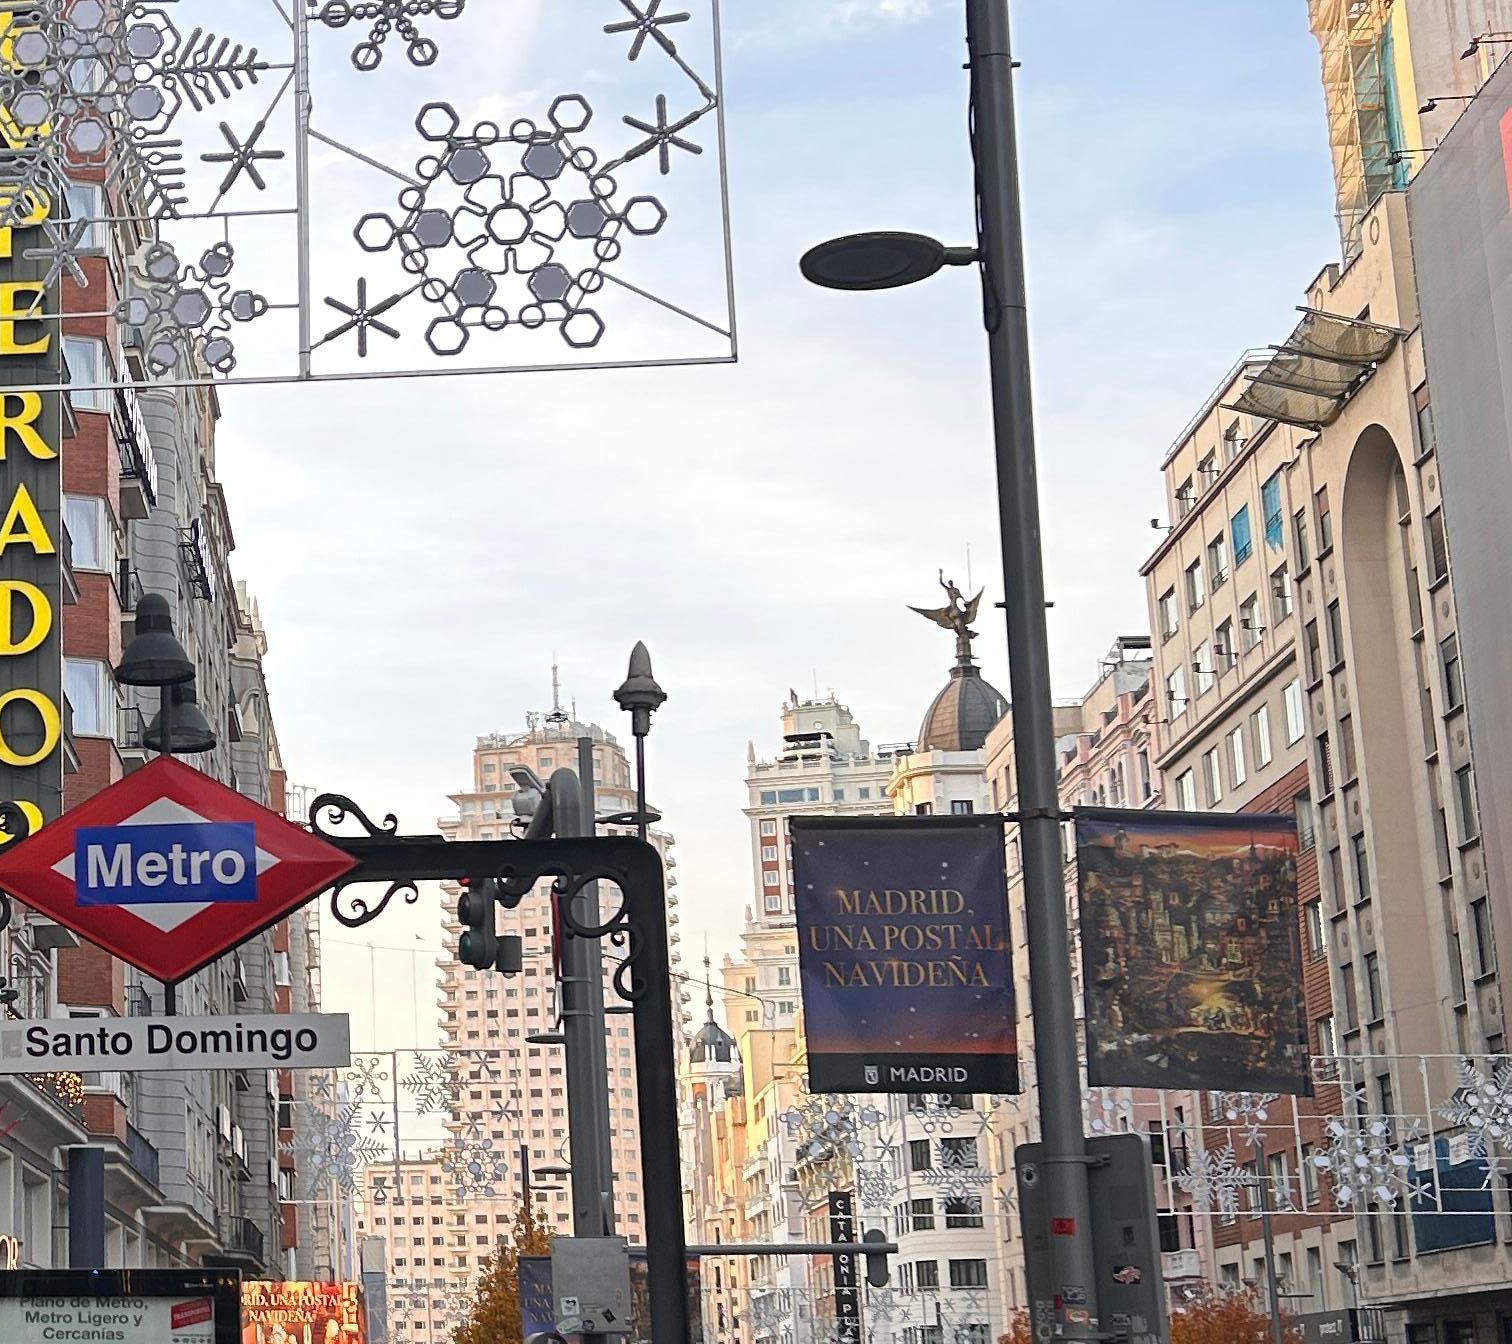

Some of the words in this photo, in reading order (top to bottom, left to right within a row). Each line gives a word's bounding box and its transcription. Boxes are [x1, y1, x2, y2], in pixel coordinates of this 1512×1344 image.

[88, 843, 246, 888] Metro
[835, 889, 975, 917] MADRID,
[809, 925, 877, 951] UNA
[883, 924, 1004, 951] POSTAL
[823, 955, 991, 987] NAVIDEÑA
[26, 1025, 133, 1057] Santo
[147, 1022, 318, 1060] Domingo
[890, 1067, 969, 1082] MADRID
[20, 1296, 66, 1308] Plano
[70, 1296, 89, 1308] de
[25, 1311, 73, 1324] Metro
[77, 1311, 129, 1327] Ligero
[134, 1314, 143, 1327] y
[249, 1308, 314, 1323] NAVIDEÑA
[43, 1327, 125, 1340] Cercanías
